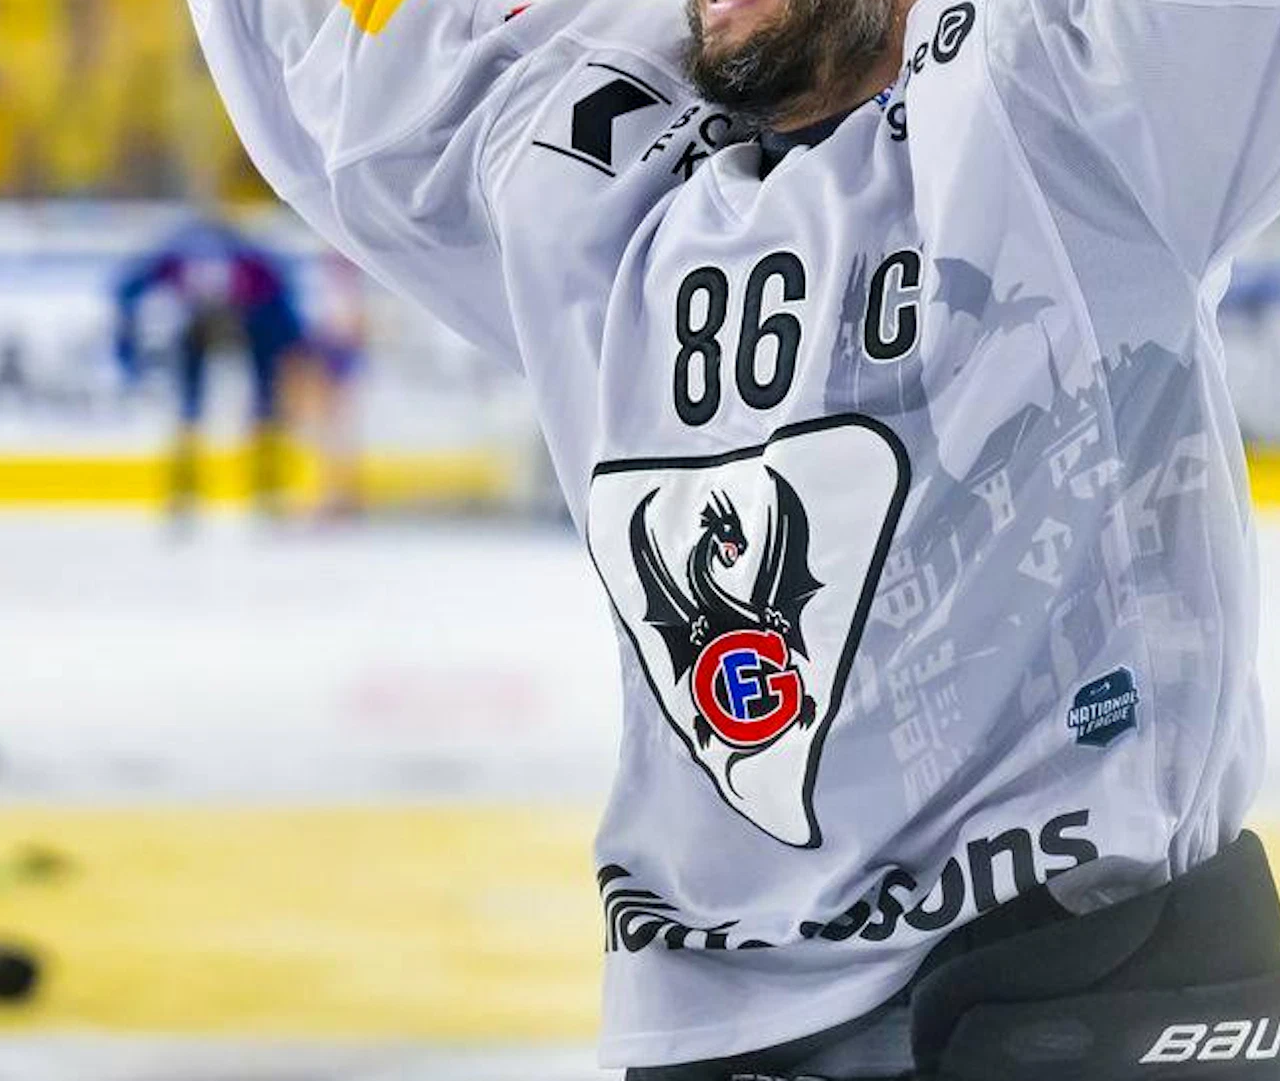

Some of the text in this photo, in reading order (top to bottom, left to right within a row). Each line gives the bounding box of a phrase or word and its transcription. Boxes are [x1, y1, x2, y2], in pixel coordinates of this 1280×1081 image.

[673, 249, 923, 427] 86 C
[1068, 688, 1138, 728] NATIONAL
[1078, 704, 1131, 737] LEAGUE
